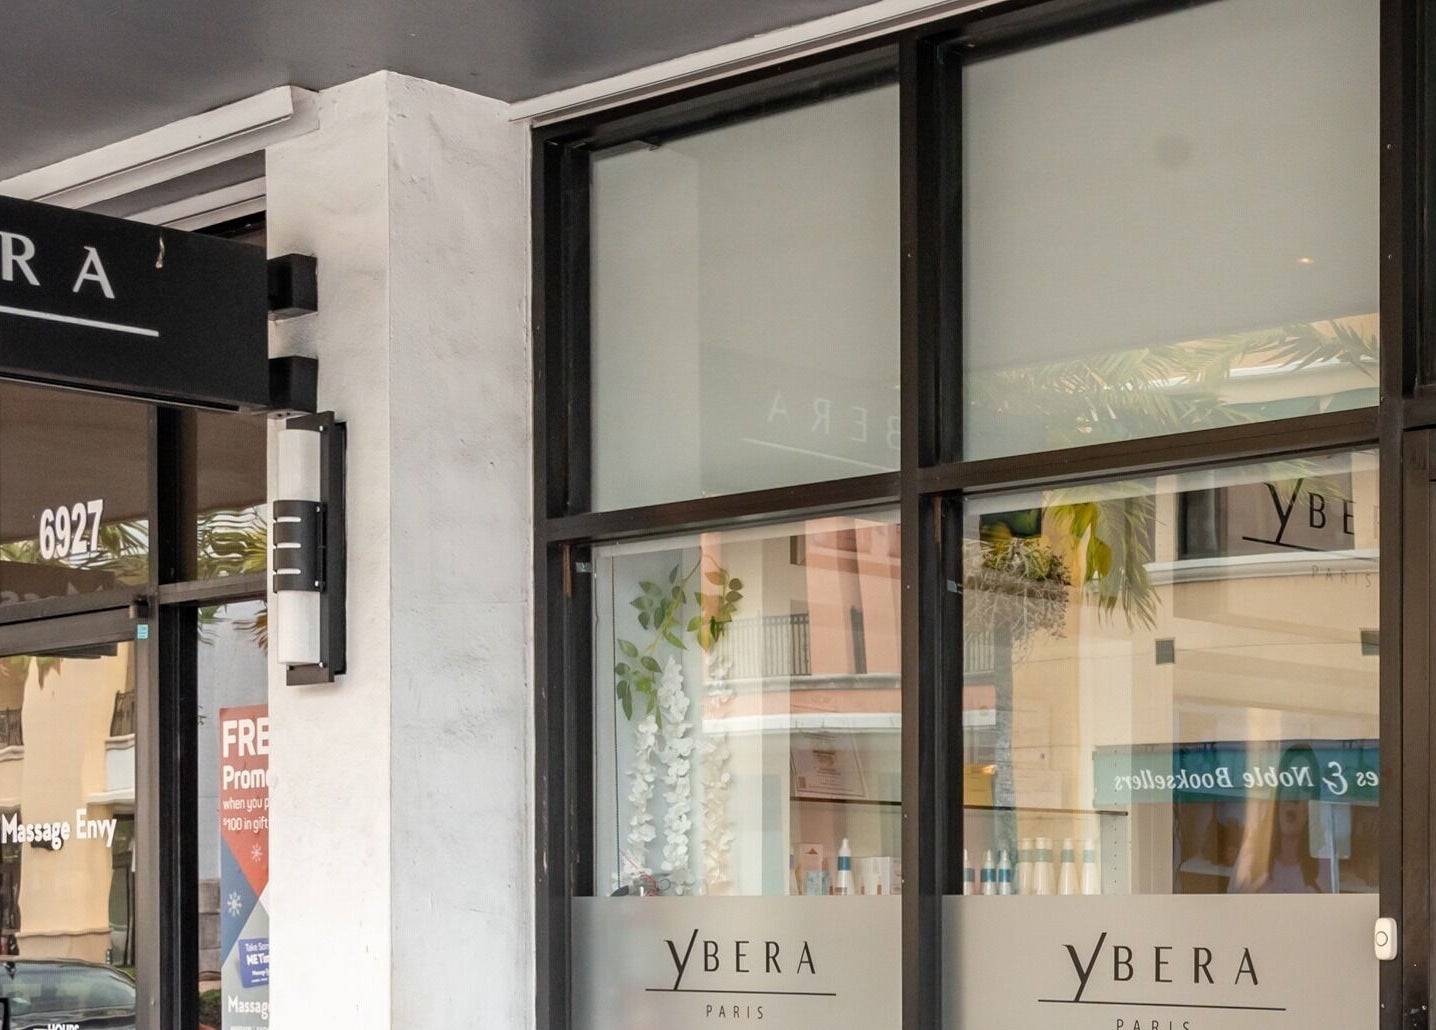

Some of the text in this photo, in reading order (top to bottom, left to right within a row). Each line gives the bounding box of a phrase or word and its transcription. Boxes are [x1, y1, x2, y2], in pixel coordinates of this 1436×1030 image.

[39, 499, 103, 561] 6927
[223, 796, 245, 810] when
[246, 798, 263, 813] you
[243, 818, 252, 830] in
[1, 808, 117, 850] Massage Envy
[664, 928, 816, 991] YBERA
[1062, 932, 1260, 1001] YBERA
[706, 1005, 764, 1019] PARIS
